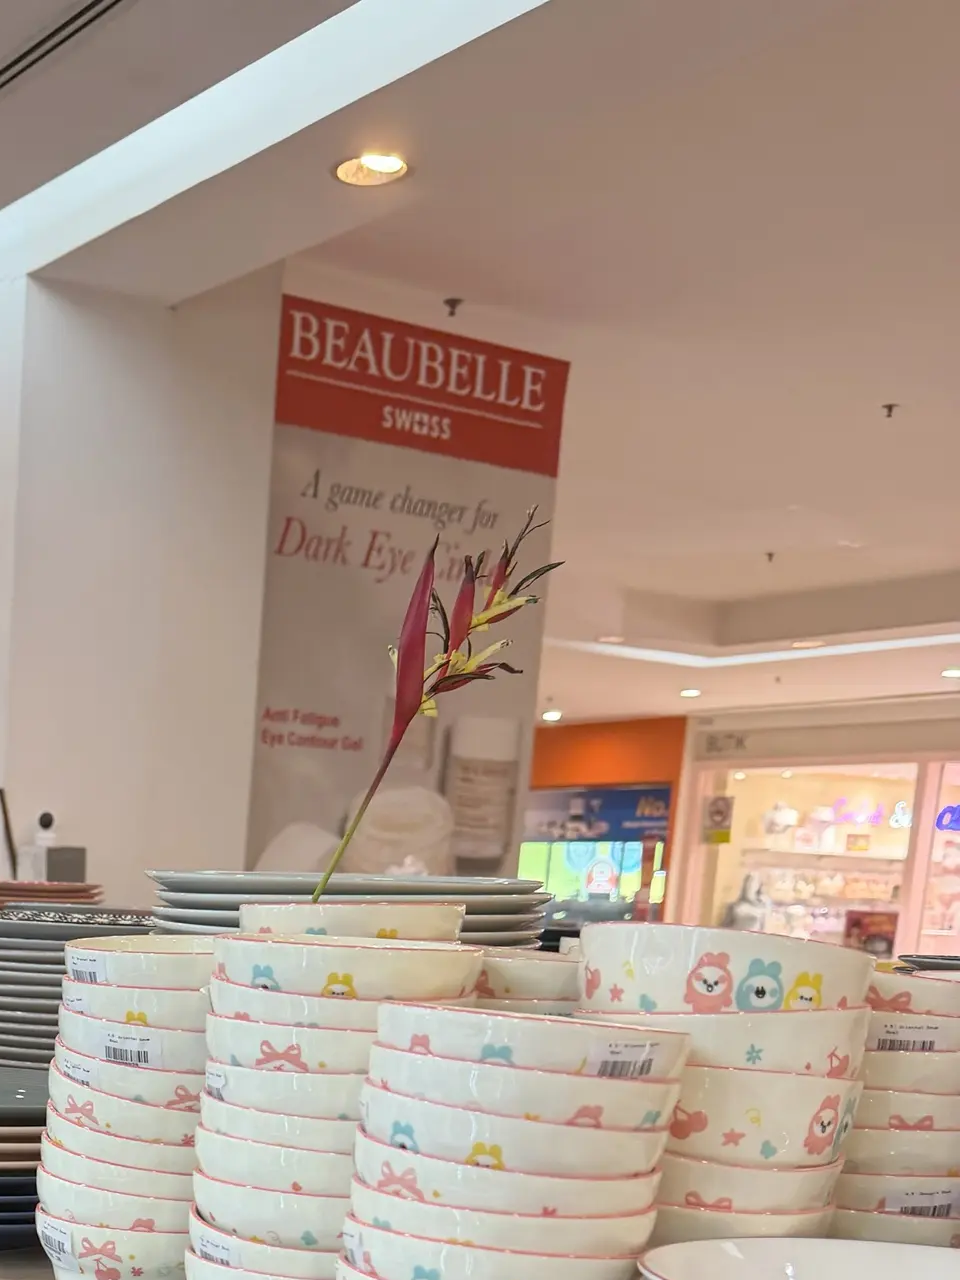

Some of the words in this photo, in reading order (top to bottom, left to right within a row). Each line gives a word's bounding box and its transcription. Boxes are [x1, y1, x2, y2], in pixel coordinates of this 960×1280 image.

[288, 309, 547, 412] BEAUBELLE
[300, 468, 322, 499] A
[326, 478, 381, 512] game
[389, 484, 468, 529] changer
[471, 498, 499, 536] for
[274, 516, 353, 566] Dark
[361, 529, 415, 584] Eye
[261, 705, 288, 722] Anti
[290, 708, 340, 728] Fatigue
[261, 730, 283, 748] Eye
[286, 731, 339, 750] Contour
[342, 735, 364, 751] Gel
